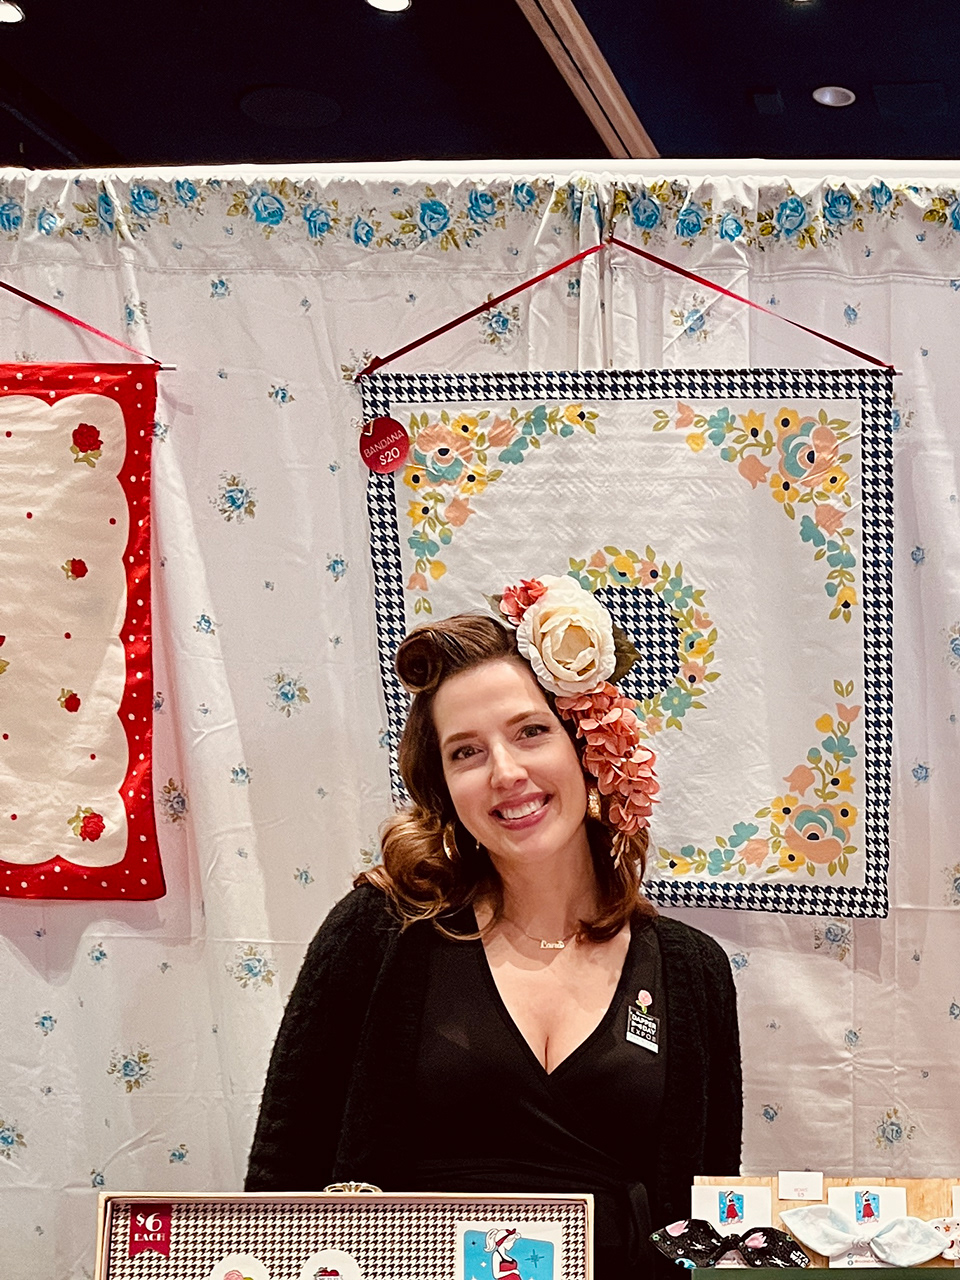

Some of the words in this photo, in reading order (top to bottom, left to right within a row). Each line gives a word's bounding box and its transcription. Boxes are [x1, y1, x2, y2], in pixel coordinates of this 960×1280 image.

[363, 429, 405, 458] BANDANA
[379, 447, 400, 466] $20
[642, 1025, 656, 1035] DAY
[135, 1212, 163, 1232] $6
[134, 1232, 166, 1242] EACH
[792, 1250, 808, 1264] STA
